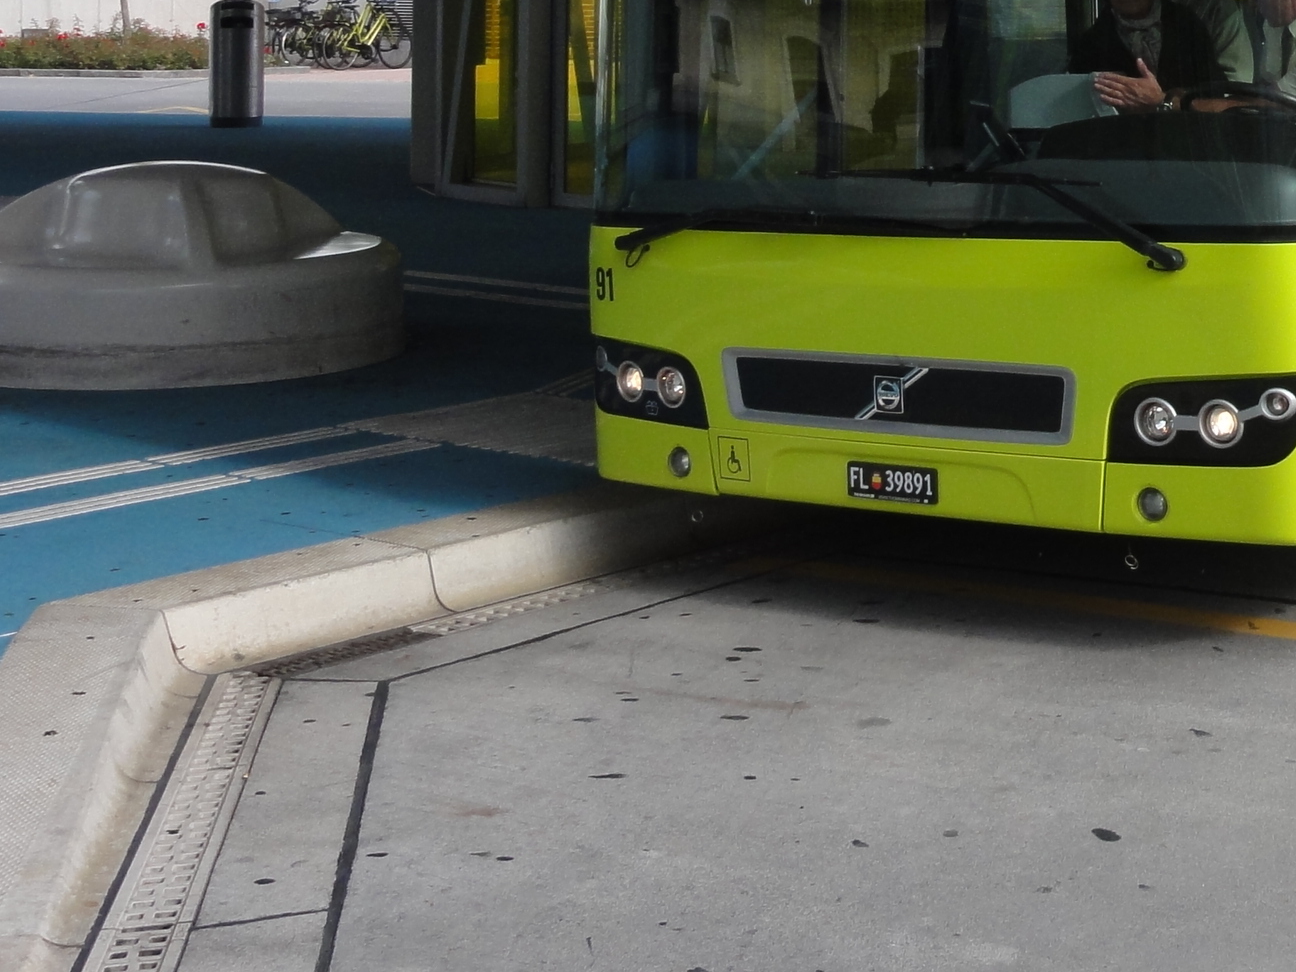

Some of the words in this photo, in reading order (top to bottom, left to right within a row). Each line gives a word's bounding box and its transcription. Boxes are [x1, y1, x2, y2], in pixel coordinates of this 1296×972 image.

[596, 267, 614, 302] 91
[850, 467, 869, 490] FL
[885, 470, 932, 495] 39891
